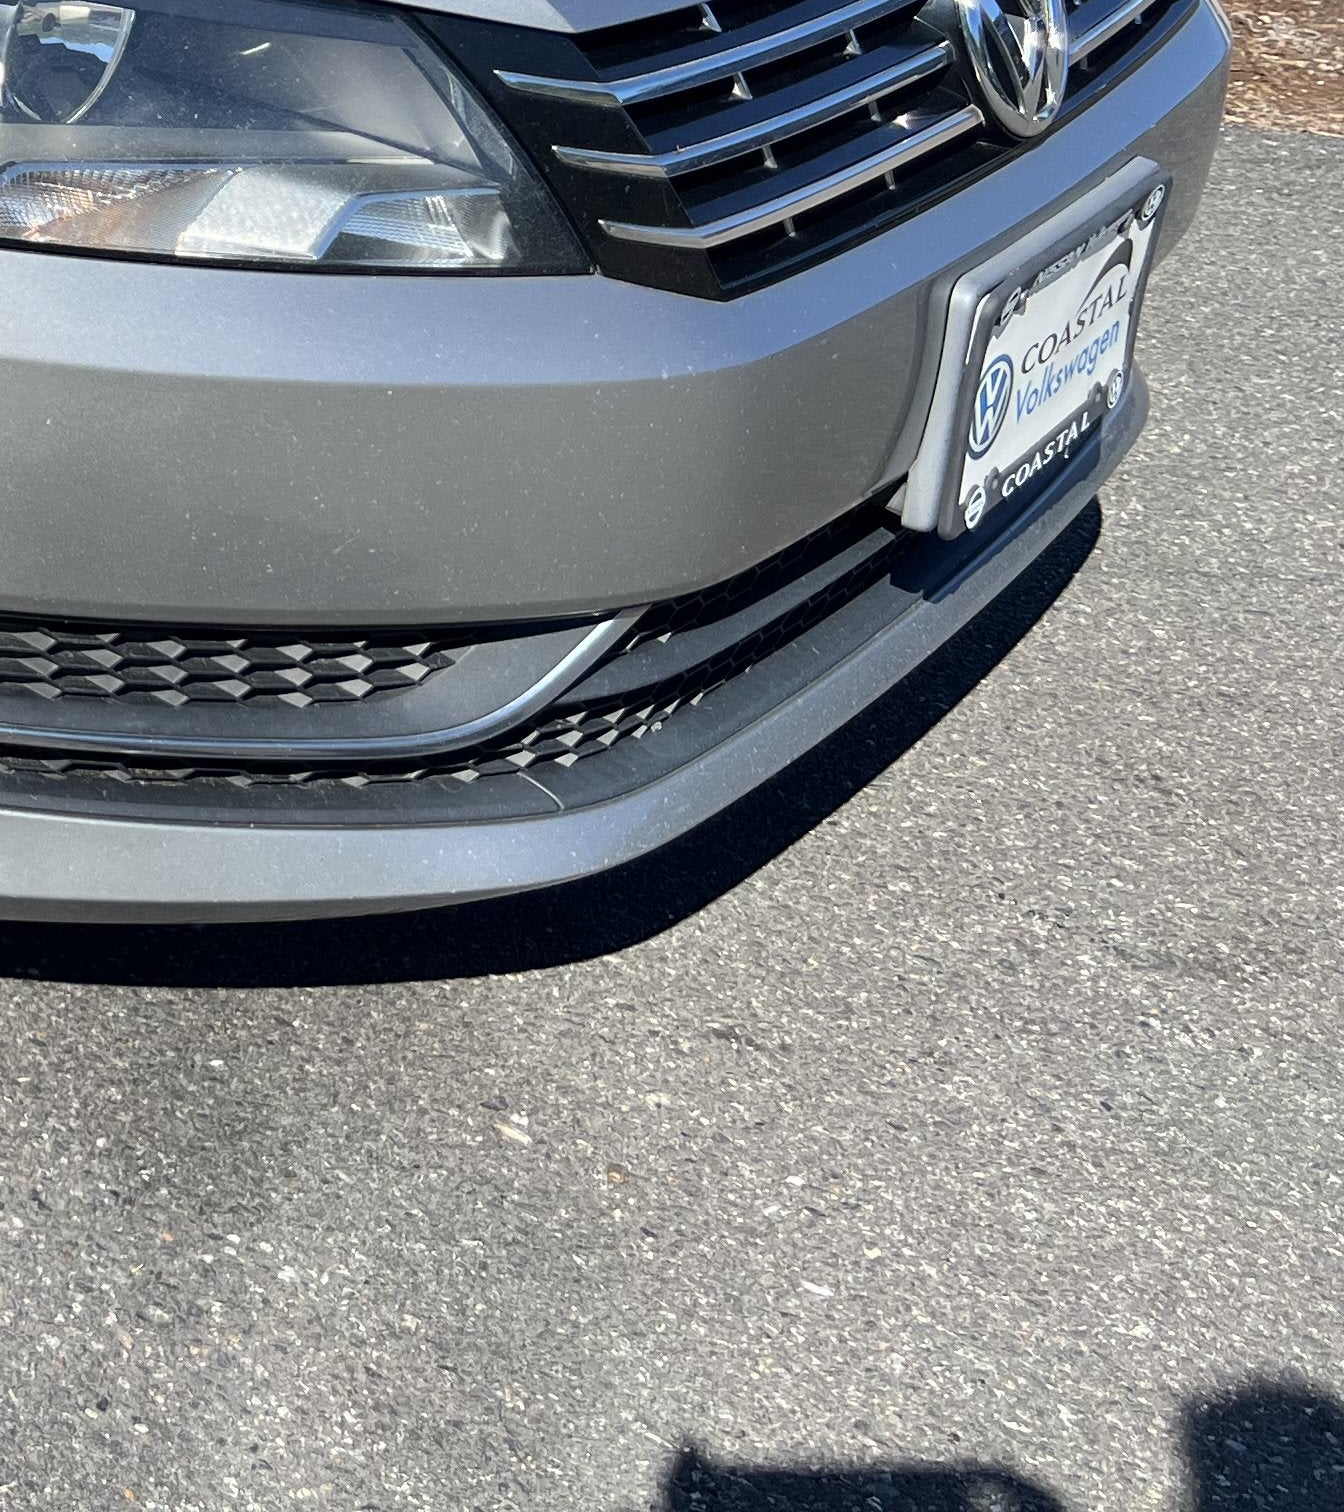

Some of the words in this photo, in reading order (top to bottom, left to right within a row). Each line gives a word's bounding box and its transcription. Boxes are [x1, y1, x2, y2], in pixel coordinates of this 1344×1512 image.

[1015, 320, 1121, 425] Volkswagen
[1020, 274, 1128, 374] COASTAL
[1001, 411, 1090, 498] COASTAL
